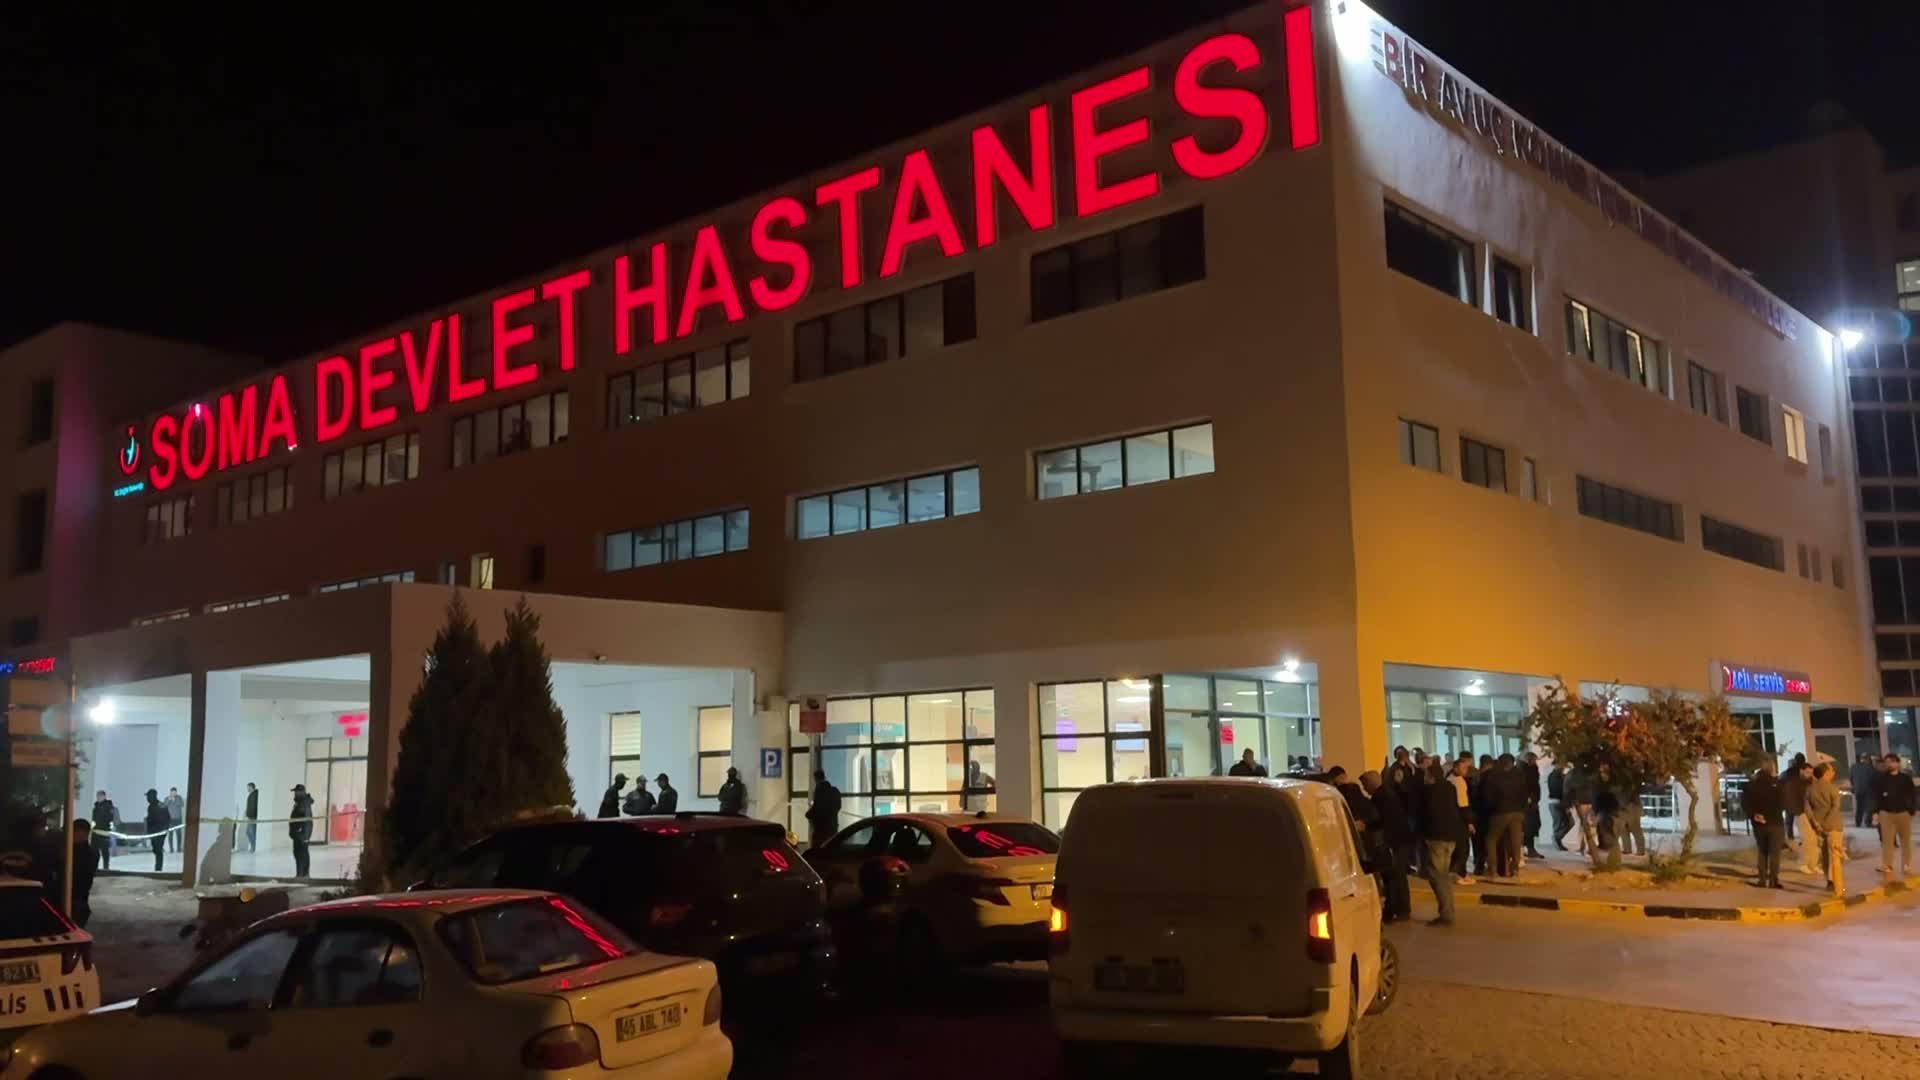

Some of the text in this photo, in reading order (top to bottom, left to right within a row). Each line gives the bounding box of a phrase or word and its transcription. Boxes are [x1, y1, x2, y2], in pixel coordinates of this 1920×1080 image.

[149, 375, 299, 490] SOMA
[316, 270, 592, 442] DEVLET
[764, 750, 777, 776] P
